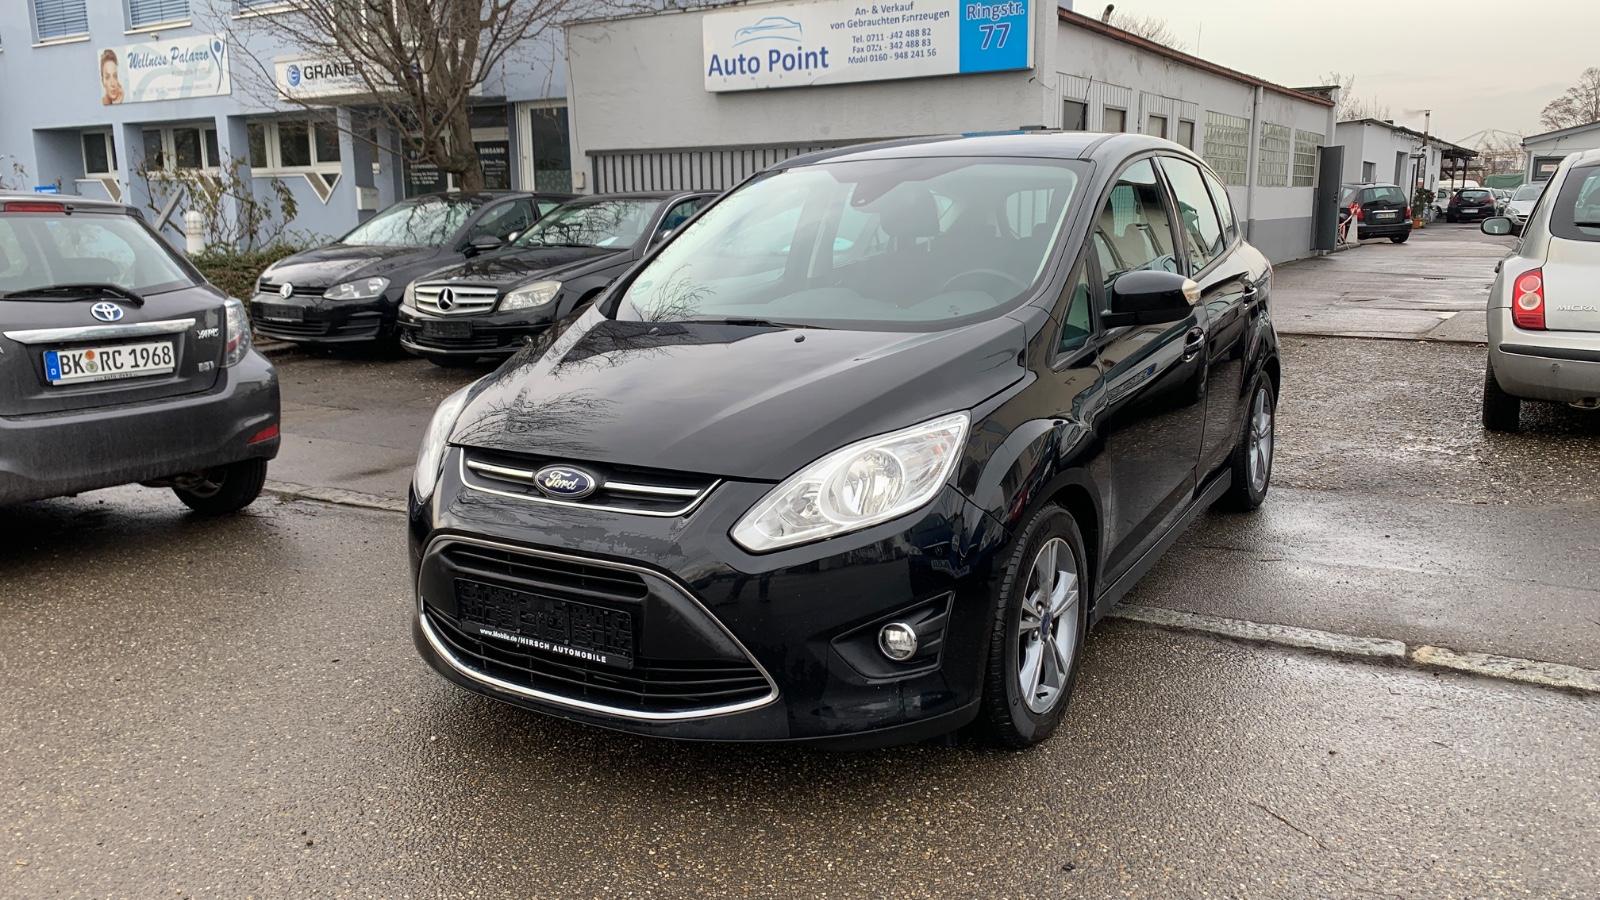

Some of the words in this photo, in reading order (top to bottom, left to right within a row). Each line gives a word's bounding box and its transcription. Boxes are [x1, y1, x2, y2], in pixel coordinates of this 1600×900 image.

[855, 7, 870, 16] An-
[871, 5, 878, 14] &
[880, 1, 914, 13] Verkauf
[966, 1, 1025, 21] Ringstr.
[830, 21, 845, 30] von
[847, 15, 900, 28] Gebrauchten
[852, 35, 865, 44] Tel.
[866, 33, 884, 42] 0711
[905, 28, 919, 38] 488
[921, 27, 931, 37] 82
[979, 22, 1011, 50] 77
[852, 45, 864, 53] Fax
[890, 41, 903, 50] 342
[905, 40, 919, 48] 488
[921, 38, 931, 47] 83
[128, 51, 168, 69] Wellness
[170, 46, 209, 66] Palazzo
[708, 54, 760, 77] Auto
[768, 46, 829, 72] Point
[848, 54, 868, 64] Mobil
[869, 53, 888, 62] 0160
[894, 51, 908, 60] 948
[911, 49, 924, 59] 241
[927, 48, 937, 57] 56
[303, 62, 361, 80] GRANE
[1557, 304, 1598, 312] MICRA
[197, 327, 219, 339] YARIS
[60, 353, 84, 376] BK
[100, 349, 123, 372] RC
[129, 345, 172, 369] 1968
[544, 470, 579, 491] Ford
[552, 645, 607, 663] AUTOMOBILE
